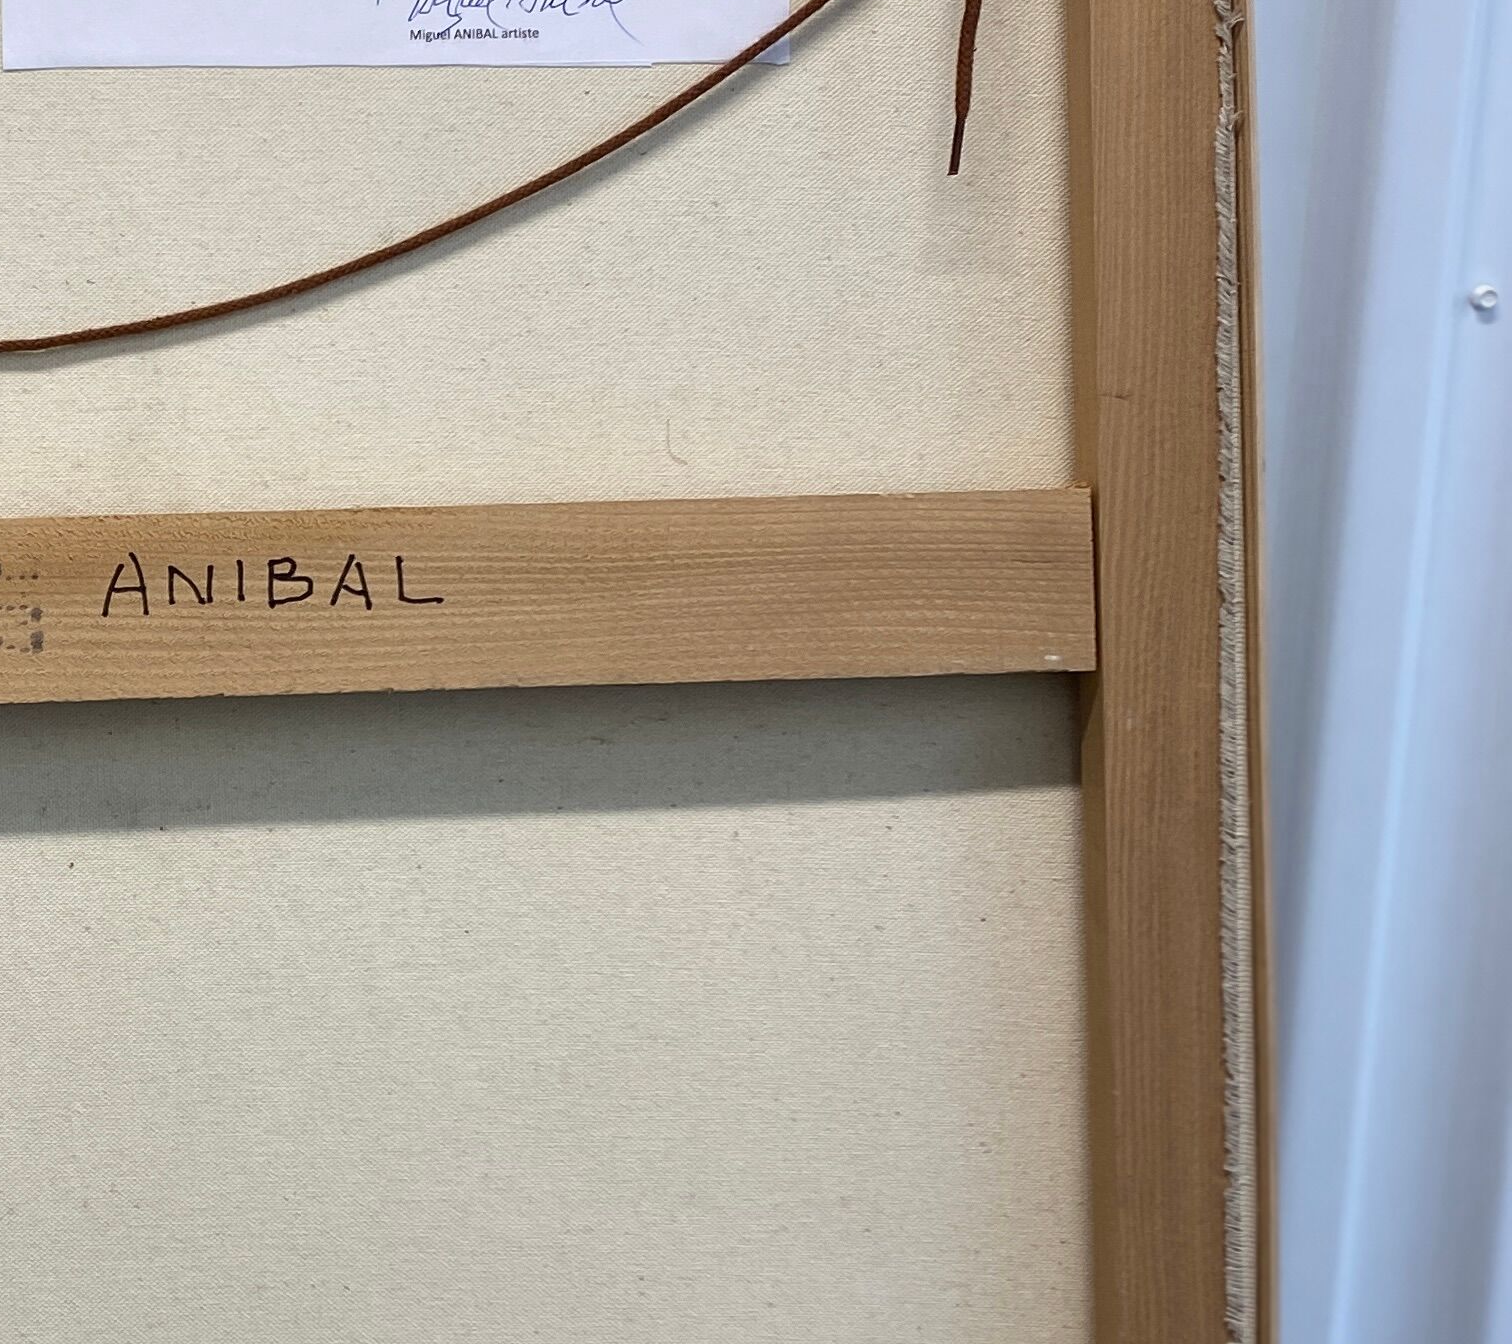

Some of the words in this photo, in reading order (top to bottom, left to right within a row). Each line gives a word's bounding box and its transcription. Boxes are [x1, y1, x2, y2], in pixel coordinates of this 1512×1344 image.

[409, 29, 451, 42] Miguel
[454, 29, 499, 40] ANIBAL
[501, 28, 539, 39] artiste
[101, 552, 445, 618] ANIBAL
